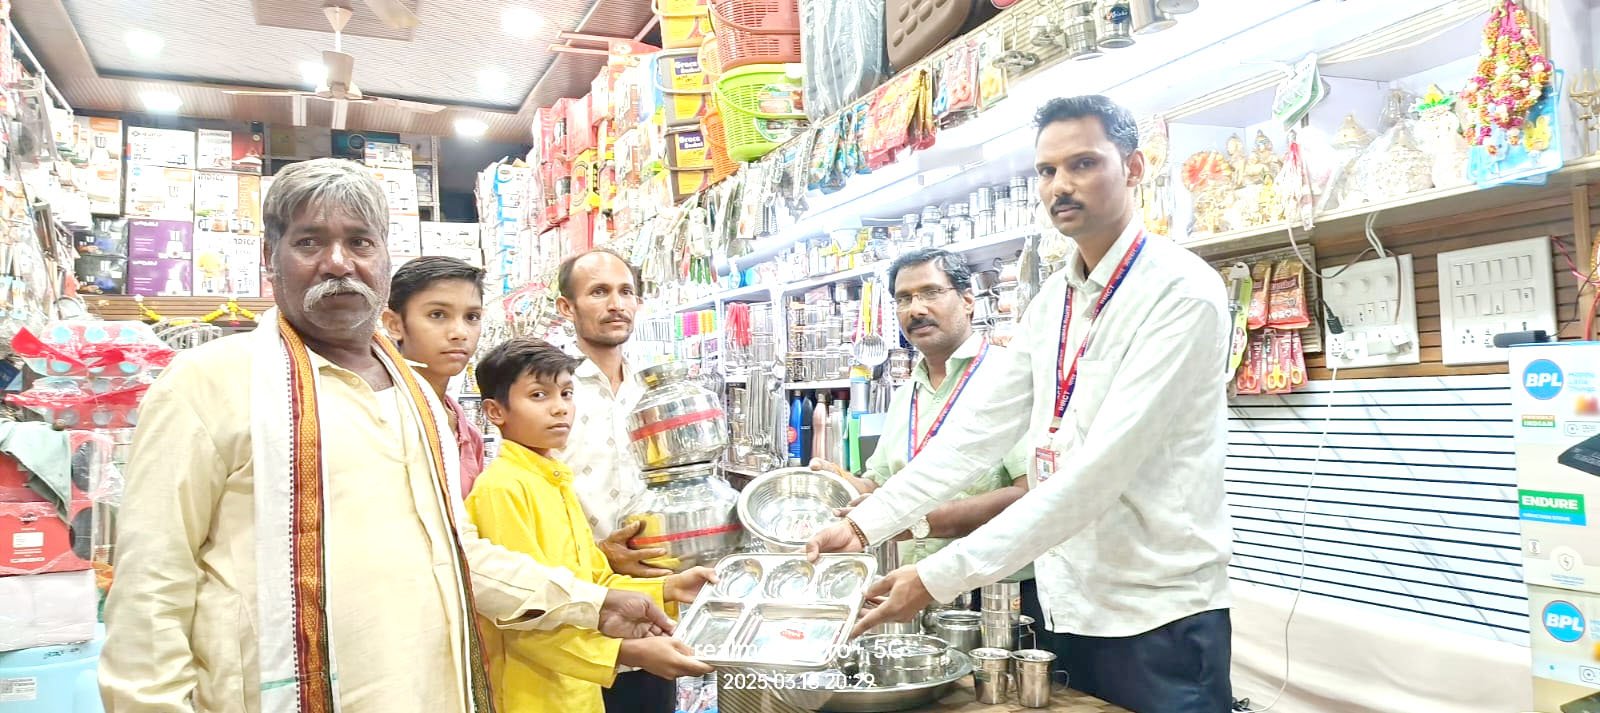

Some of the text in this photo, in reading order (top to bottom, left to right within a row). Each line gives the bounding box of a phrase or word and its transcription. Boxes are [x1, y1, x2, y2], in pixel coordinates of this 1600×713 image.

[1525, 372, 1562, 387] BPL
[1521, 495, 1578, 510] ENDURE
[1545, 612, 1584, 632] BPL
